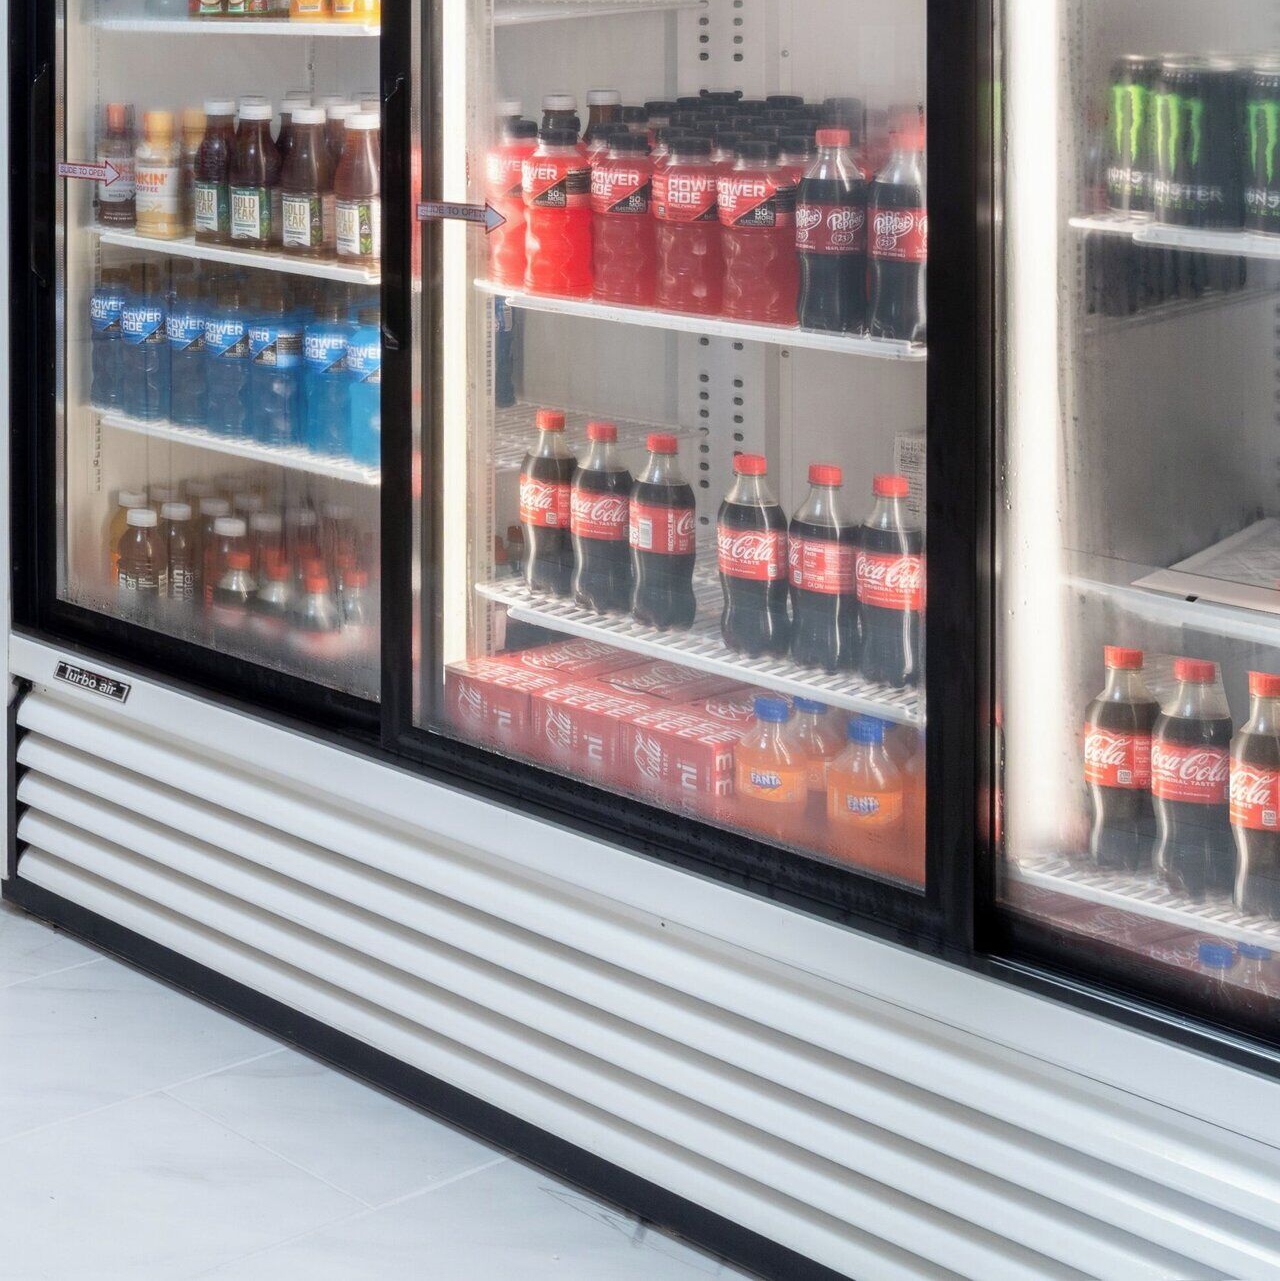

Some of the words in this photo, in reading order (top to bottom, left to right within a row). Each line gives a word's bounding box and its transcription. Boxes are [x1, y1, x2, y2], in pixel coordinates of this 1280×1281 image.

[592, 170, 639, 186] POWER
[591, 184, 612, 196] ADE
[718, 182, 765, 197] POWER
[234, 196, 256, 209] GOLD
[668, 192, 700, 204] ADE
[234, 208, 256, 219] PEAK
[448, 207, 459, 215] TO
[827, 214, 862, 230] Pepper
[123, 312, 161, 323] POWER
[123, 322, 142, 331] ADE
[205, 322, 243, 335] POWER
[205, 333, 222, 344] ADE
[305, 348, 327, 359] ADE
[65, 665, 97, 688] Turbo
[99, 682, 116, 694] air
[1152, 746, 1229, 782] Coca-Cola
[751, 771, 782, 786] FANTA
